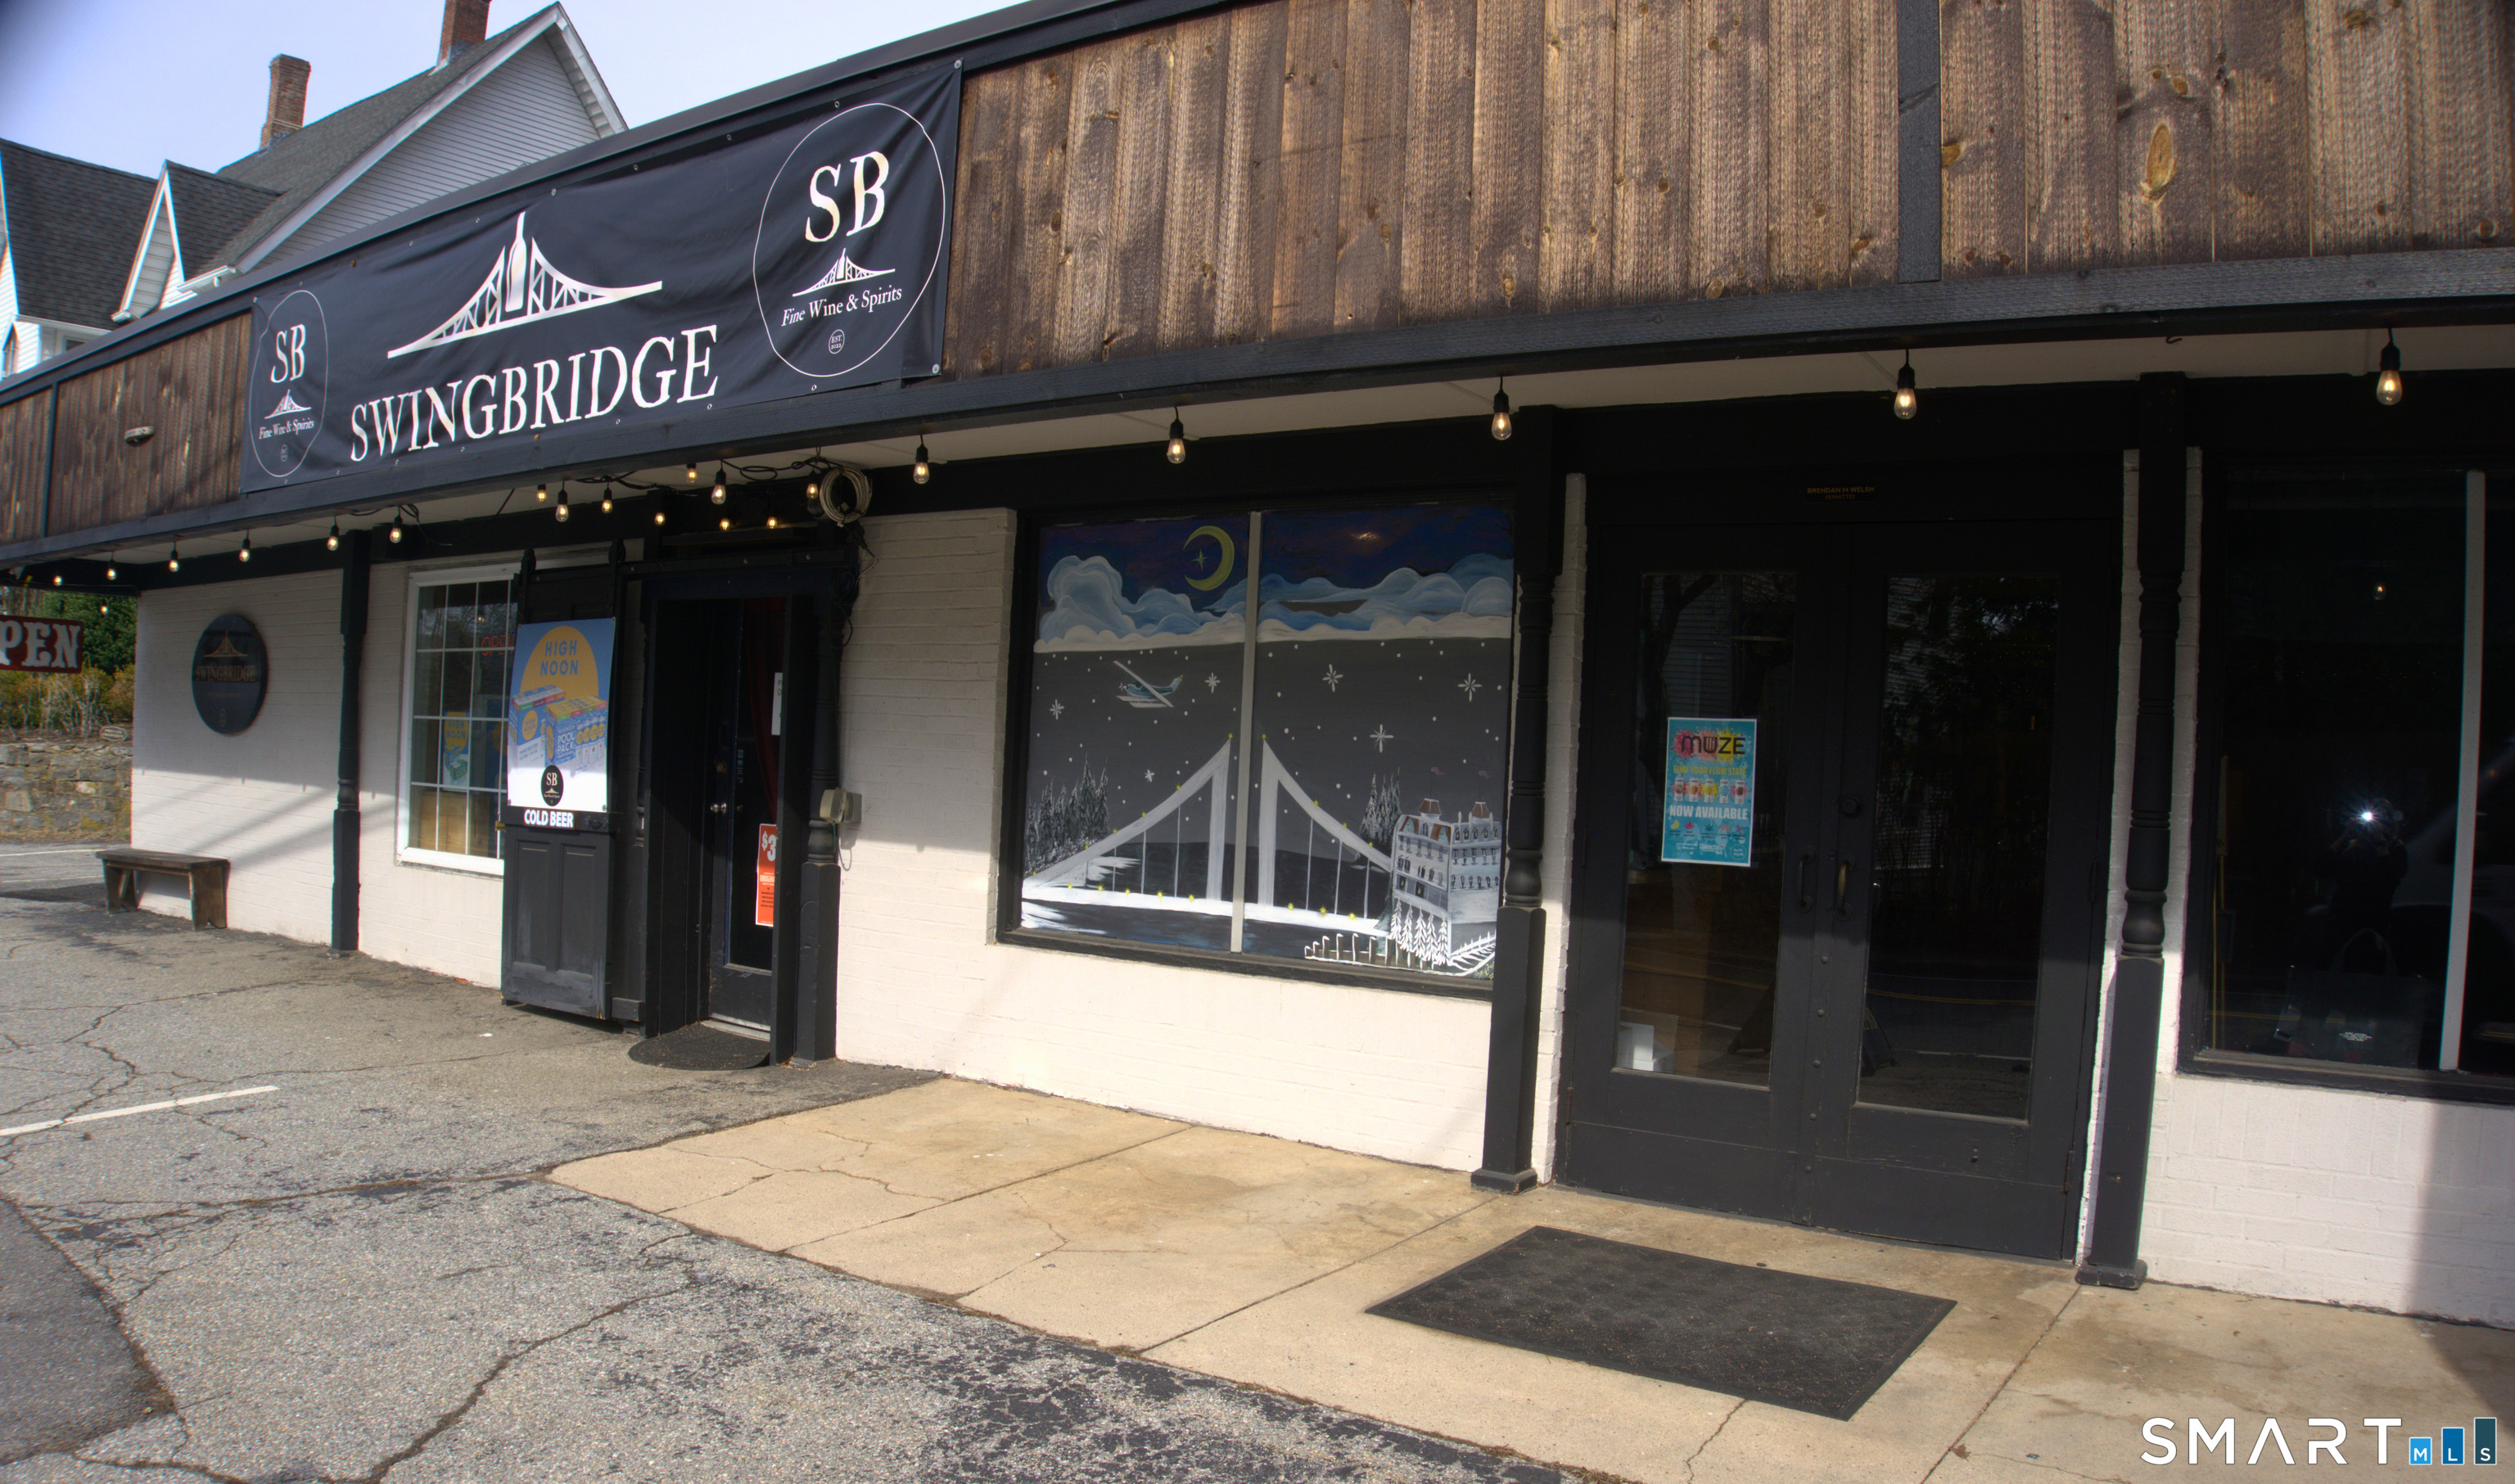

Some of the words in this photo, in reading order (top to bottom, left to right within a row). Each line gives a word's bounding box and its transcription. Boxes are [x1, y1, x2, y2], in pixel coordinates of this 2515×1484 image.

[805, 151, 890, 242] SB
[781, 307, 806, 327] Fine
[809, 298, 842, 318] Wine
[846, 294, 859, 312] &
[861, 284, 902, 313] Spirits
[270, 323, 306, 383] SB
[350, 324, 719, 462] SWINGBRIDGE
[259, 426, 273, 440] Fine
[273, 422, 286, 435] Wine
[286, 420, 292, 433] &
[292, 417, 315, 435] Spirits
[544, 639, 578, 656] HIGH
[196, 665, 256, 682] SWINGBRIDGE
[540, 659, 580, 677] NOON
[446, 730, 466, 740] NOON
[558, 731, 576, 745] POOL
[557, 742, 576, 756] PACK
[1681, 735, 1745, 755] MUZE
[546, 772, 558, 786] SB
[1673, 765, 1689, 774] FIND
[1690, 765, 1708, 775] YOUR
[1709, 766, 1727, 776] FLOW
[1727, 767, 1747, 777] STATE
[524, 809, 549, 826] COLD
[549, 811, 575, 828] BEER
[1669, 805, 1695, 818] NOW
[1695, 805, 1748, 820] AVAILABLE
